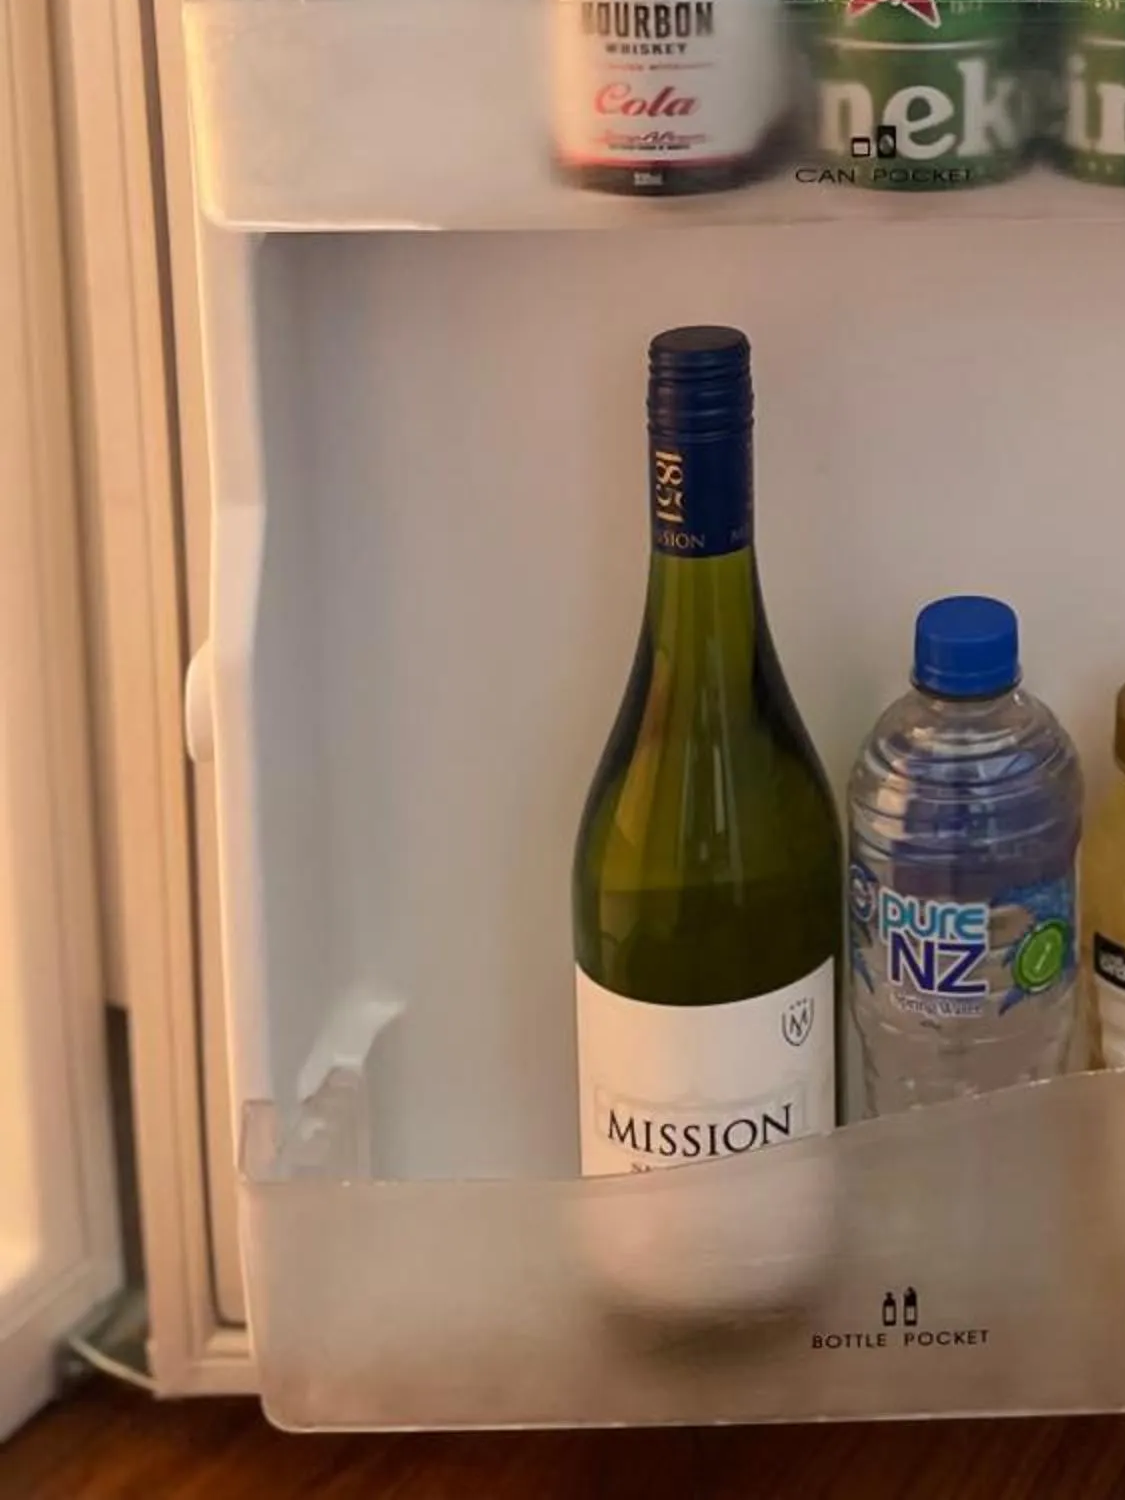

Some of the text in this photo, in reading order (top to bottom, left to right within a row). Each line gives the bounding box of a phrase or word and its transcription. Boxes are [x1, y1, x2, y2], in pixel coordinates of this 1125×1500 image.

[581, 1, 715, 39] BOURBON
[605, 42, 689, 56] WHISKEY
[593, 81, 700, 119] Cola
[795, 167, 974, 184] CAN POCKET
[881, 889, 987, 942] pure
[889, 931, 987, 994] NZ
[608, 1102, 794, 1159] MISSION
[812, 1329, 991, 1350] BOTTLE POCKET
